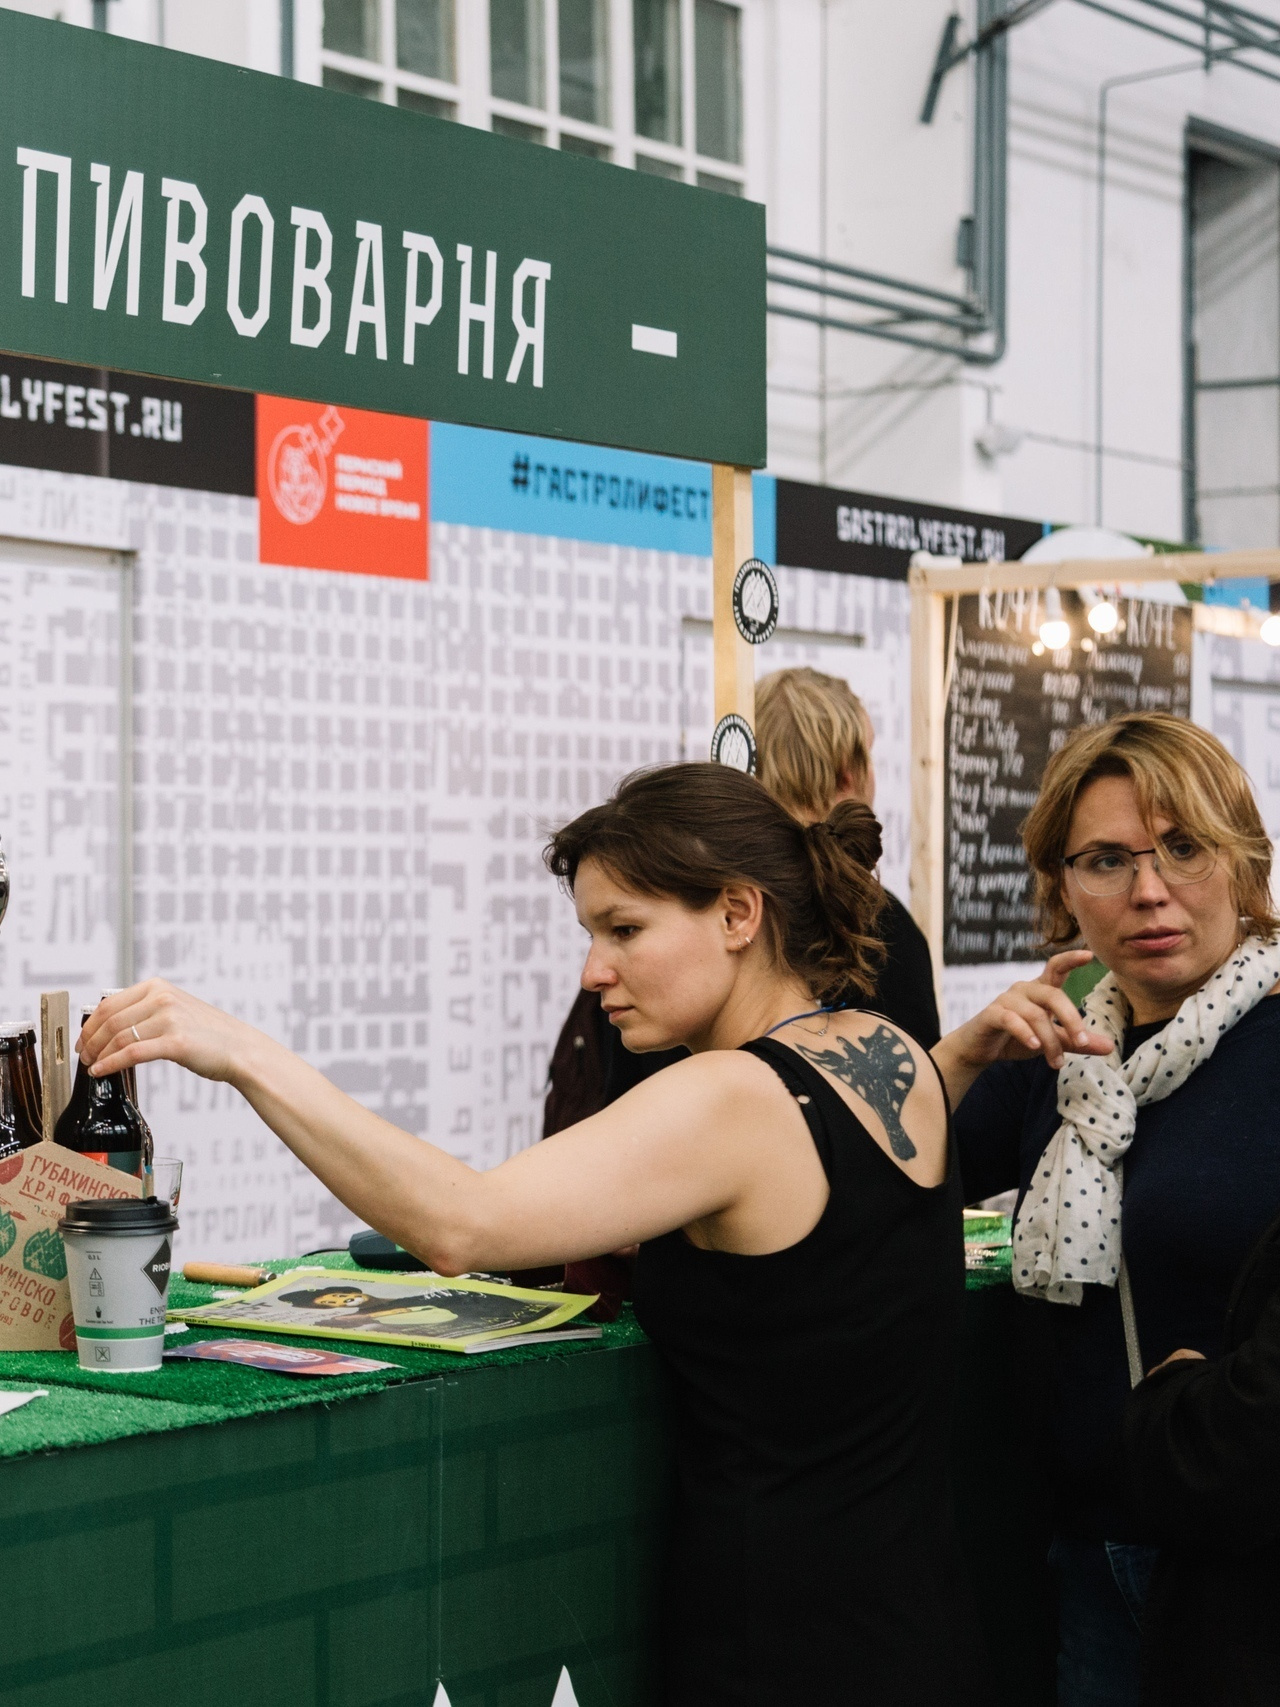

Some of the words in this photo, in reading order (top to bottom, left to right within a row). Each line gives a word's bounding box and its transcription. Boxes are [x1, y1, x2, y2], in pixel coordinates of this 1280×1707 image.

[16, 146, 552, 389] ПИВОВАРНЯ
[511, 452, 710, 520] #ГАСТРОЛИФЕСТ
[139, 1317, 155, 1326] THE
